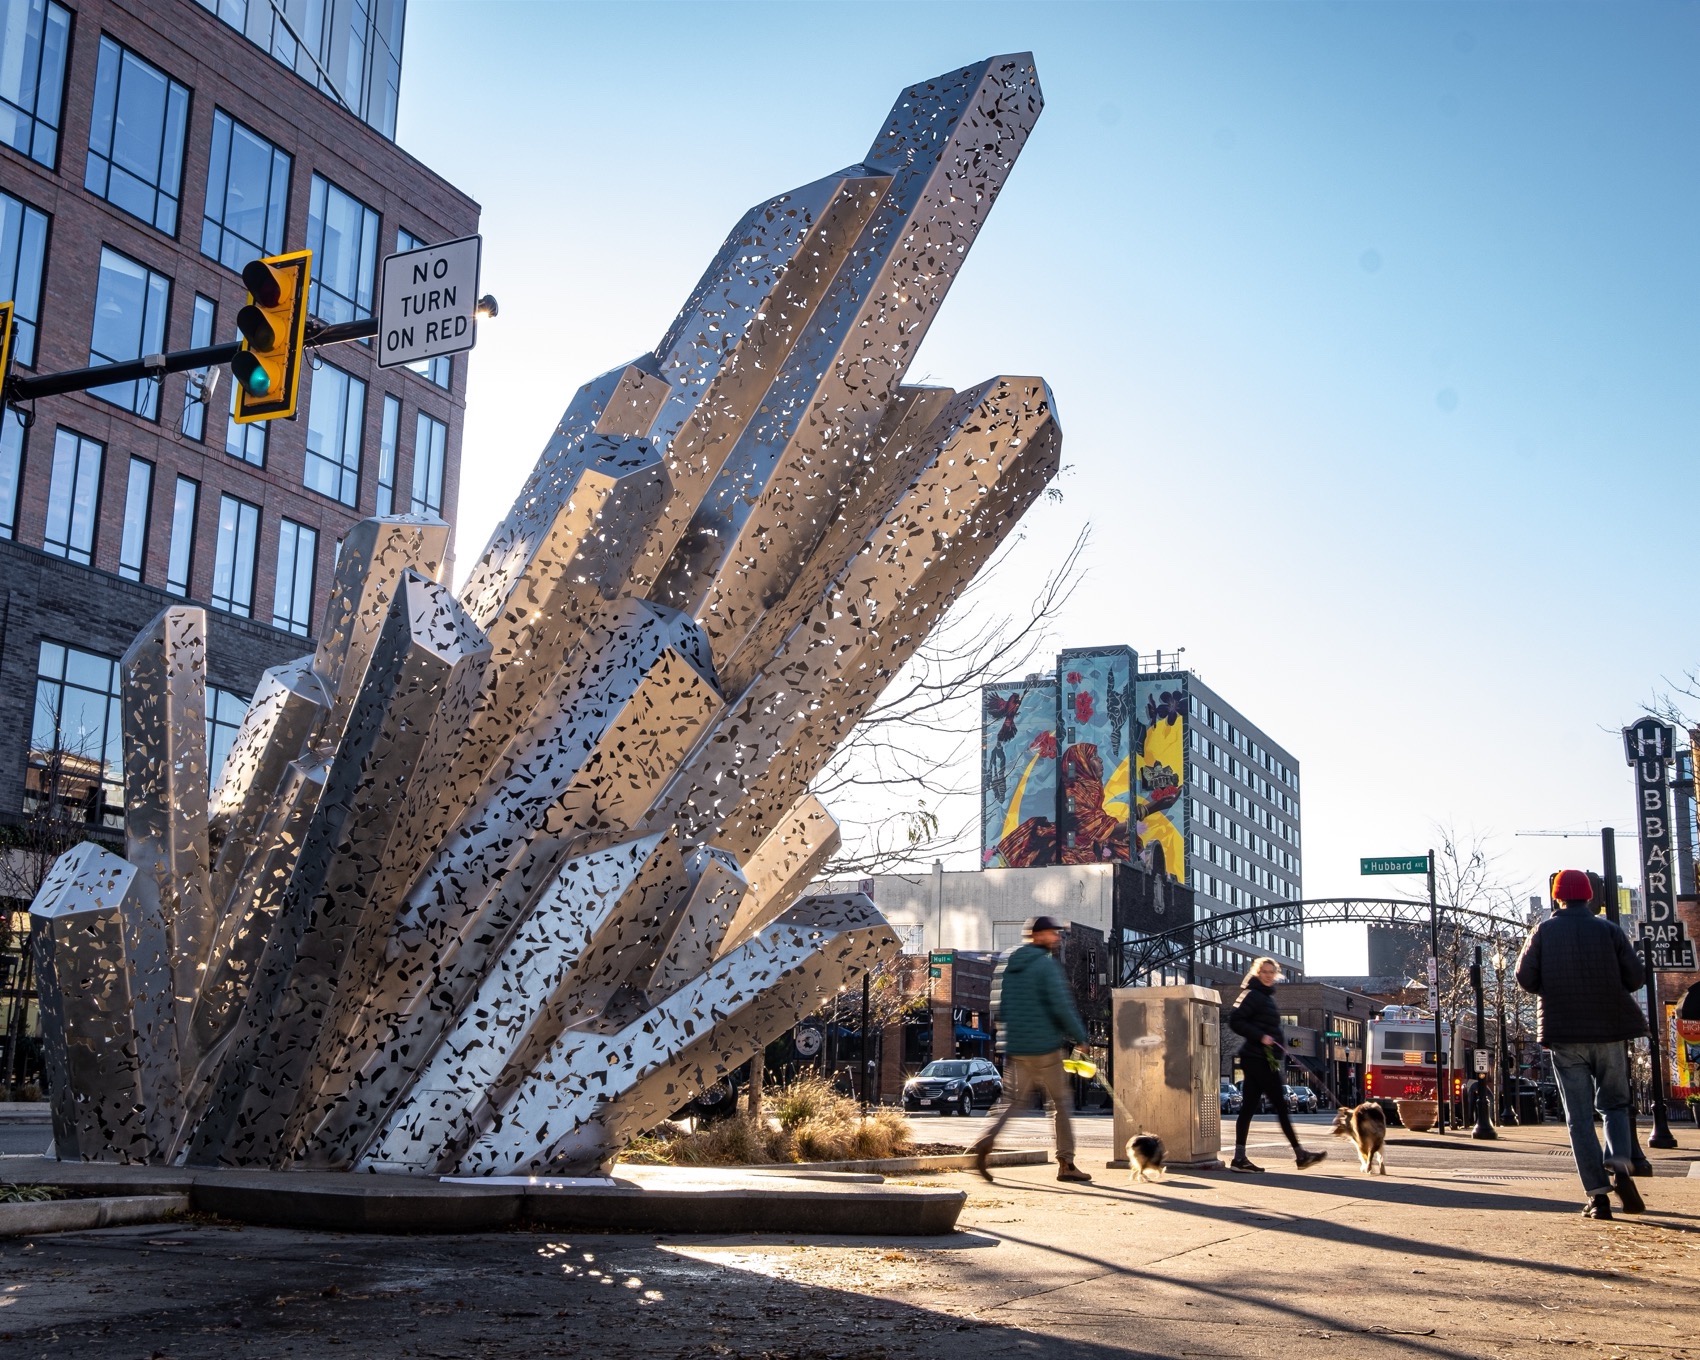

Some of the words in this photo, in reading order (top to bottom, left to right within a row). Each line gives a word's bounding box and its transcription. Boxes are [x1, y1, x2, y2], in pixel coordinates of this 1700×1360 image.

[413, 258, 448, 285] NO
[401, 286, 457, 317] TURN
[387, 326, 414, 351] ON
[426, 315, 467, 343] RED
[1637, 727, 1670, 921] HUBBARD
[1371, 861, 1412, 871] Hubbard
[1644, 925, 1679, 942] BAR
